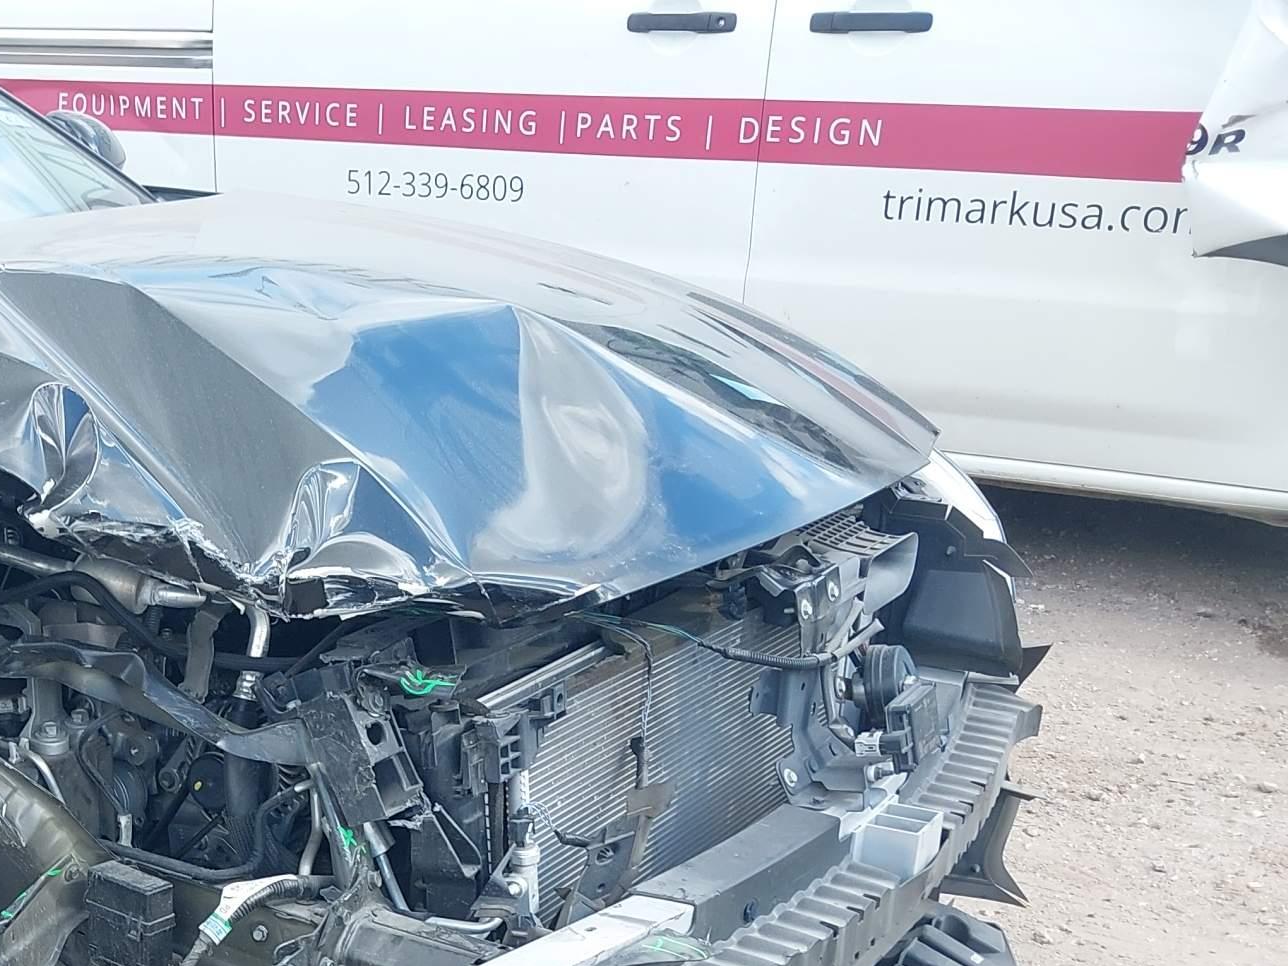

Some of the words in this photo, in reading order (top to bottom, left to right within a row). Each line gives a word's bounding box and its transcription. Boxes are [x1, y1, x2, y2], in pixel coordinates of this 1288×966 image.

[58, 92, 203, 120] EQUIPMENT
[243, 99, 358, 127] SERVICE
[405, 105, 537, 137] LEASING
[739, 117, 883, 146] DESIGN
[347, 169, 524, 203] 512-339-6809
